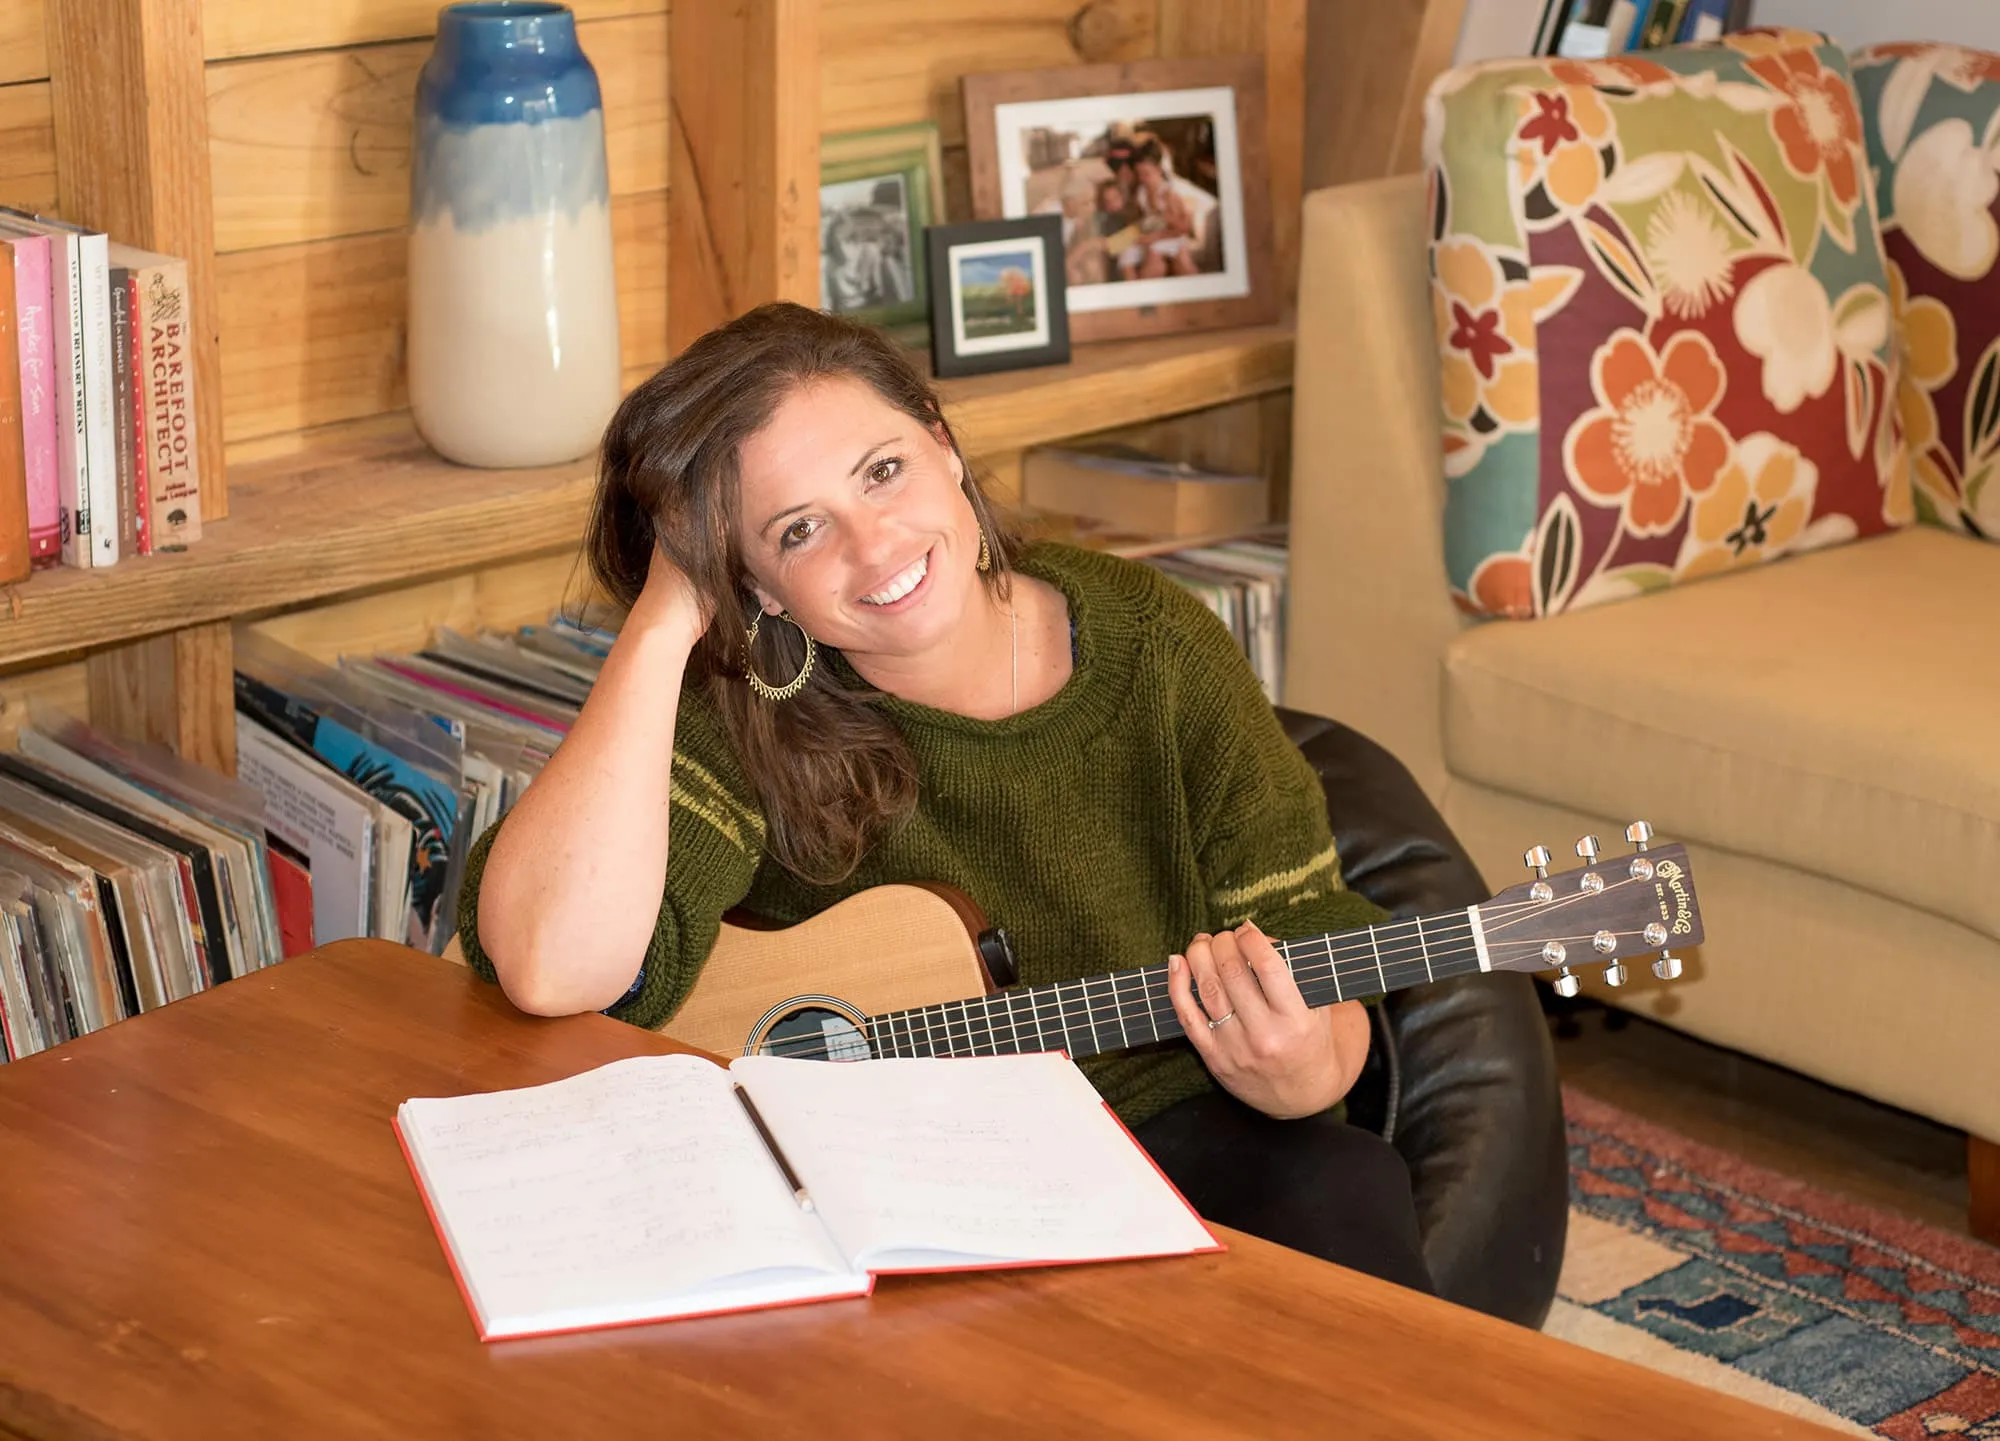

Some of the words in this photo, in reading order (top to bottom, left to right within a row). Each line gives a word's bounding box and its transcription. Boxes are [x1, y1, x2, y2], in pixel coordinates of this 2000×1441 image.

[74, 331, 82, 386] TREASURE
[151, 326, 173, 476] ARCHITECT
[166, 323, 189, 471] BAREFOOT
